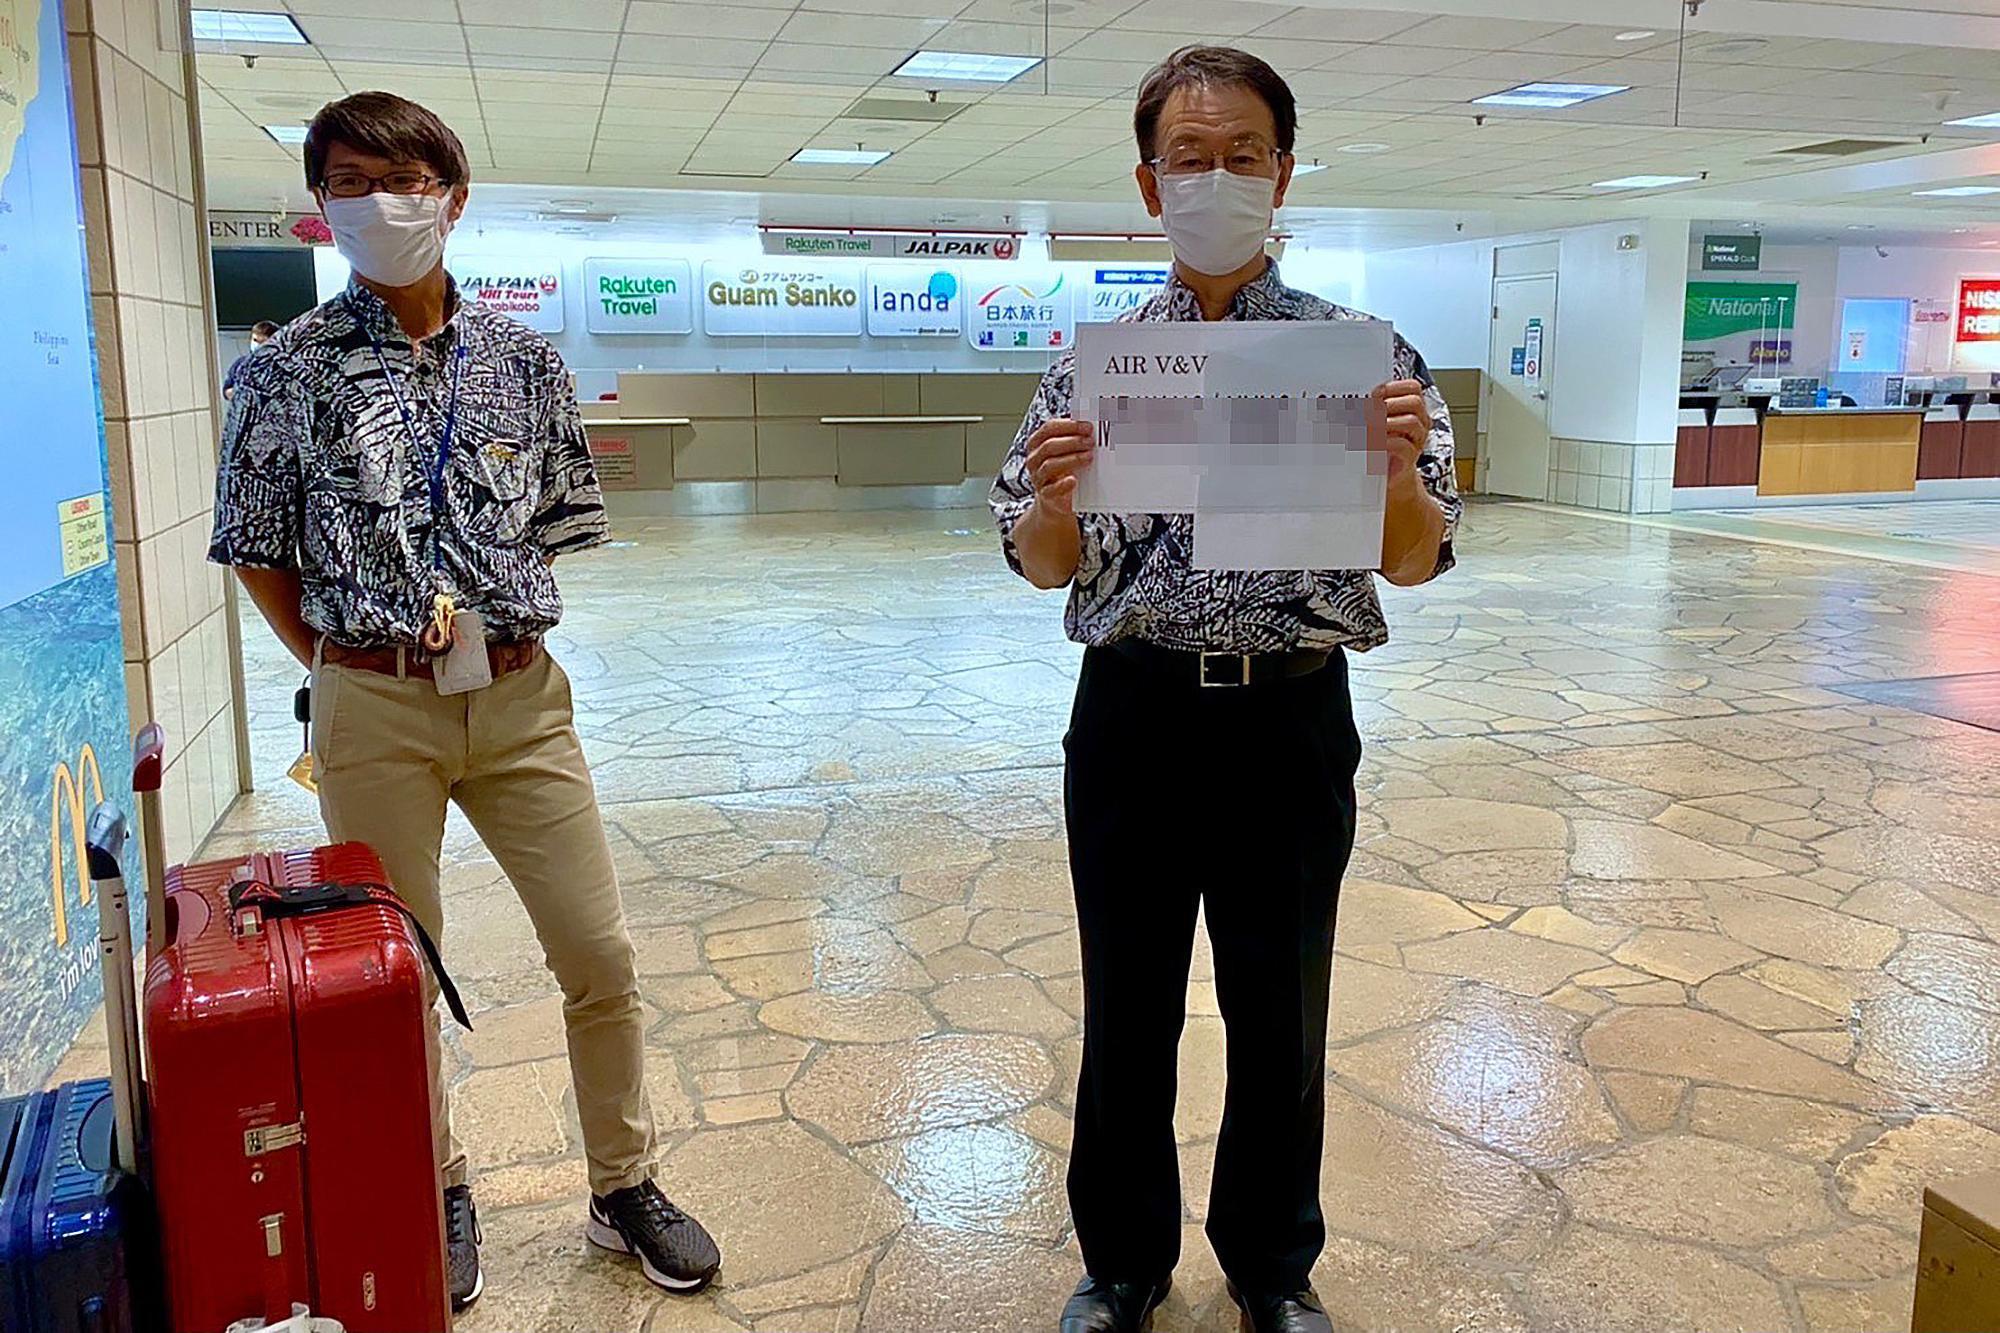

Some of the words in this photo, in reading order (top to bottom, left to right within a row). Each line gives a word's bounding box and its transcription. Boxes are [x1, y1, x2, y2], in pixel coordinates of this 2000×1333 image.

[785, 237, 834, 252] Rakuten
[837, 239, 871, 251] Travel
[904, 241, 989, 255] JALPAK
[460, 276, 537, 288] JALPAK
[599, 275, 677, 295] Rakuten
[477, 289, 502, 299] MHI
[505, 290, 539, 299] Tours
[708, 281, 778, 306] Guam
[785, 282, 857, 307] Sanko
[873, 285, 949, 312] landa
[601, 298, 657, 315] Travel
[986, 305, 1054, 321] 日本旅行
[1708, 298, 1779, 316] National
[1104, 355, 1148, 374] AIR
[1155, 355, 1209, 375] V&V
